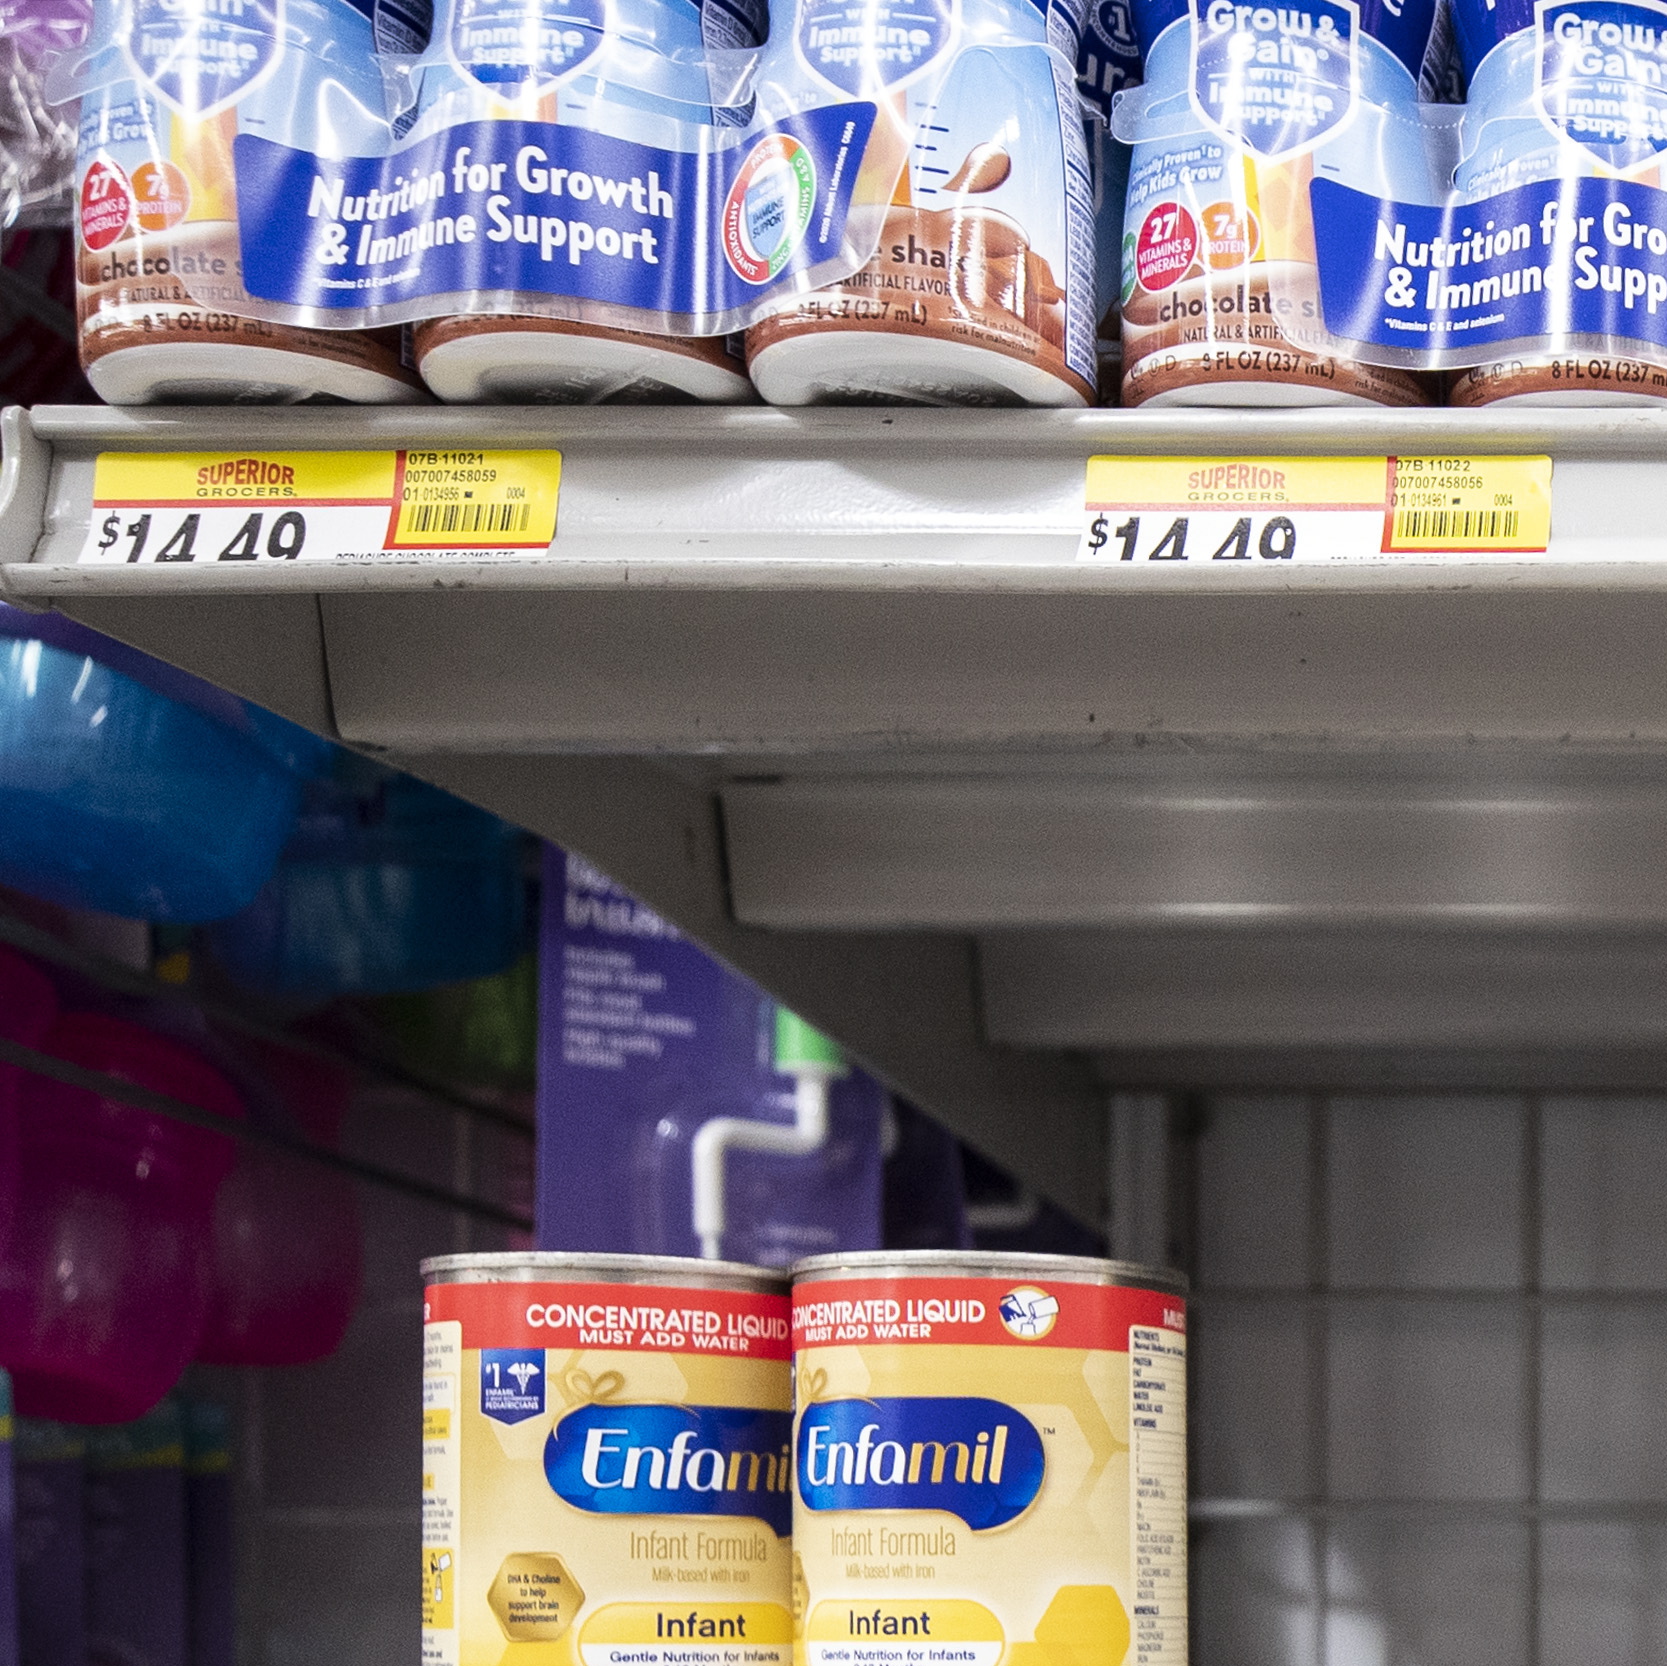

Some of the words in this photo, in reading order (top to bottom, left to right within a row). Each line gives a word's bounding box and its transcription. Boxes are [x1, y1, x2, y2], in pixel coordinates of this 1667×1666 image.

[308, 164, 446, 225] Nutrition
[451, 148, 510, 195] for
[518, 145, 674, 220] Growth
[316, 228, 350, 268] &
[356, 216, 478, 266] Immune
[486, 195, 661, 264] Support
[1374, 214, 1534, 268] Nutrition
[1539, 203, 1597, 247] for
[1384, 268, 1418, 309] &
[1426, 255, 1571, 308] Immune
[1551, 362, 1562, 380] 8
[1566, 362, 1586, 380] FL
[1589, 361, 1611, 379] OZ
[1616, 362, 1649, 386] (237
[196, 459, 295, 486] SUPERIOR
[526, 1304, 723, 1333] CONCENTRATED
[727, 1311, 788, 1341] LIQUID
[906, 1299, 986, 1324] LIQUID
[579, 1328, 636, 1347] MUST
[640, 1331, 684, 1349] ADD
[691, 1332, 750, 1351] WATER
[581, 1428, 792, 1492] Enfami
[806, 1425, 1008, 1485] Enfamil
[831, 1526, 874, 1558] Infant
[879, 1528, 956, 1558] Formula
[656, 1612, 746, 1639] Infant
[849, 1611, 931, 1635] Infant
[821, 1649, 855, 1662] Gentle
[856, 1649, 903, 1662] Nutrition
[906, 1648, 924, 1660] for
[929, 1648, 975, 1661] Infants
